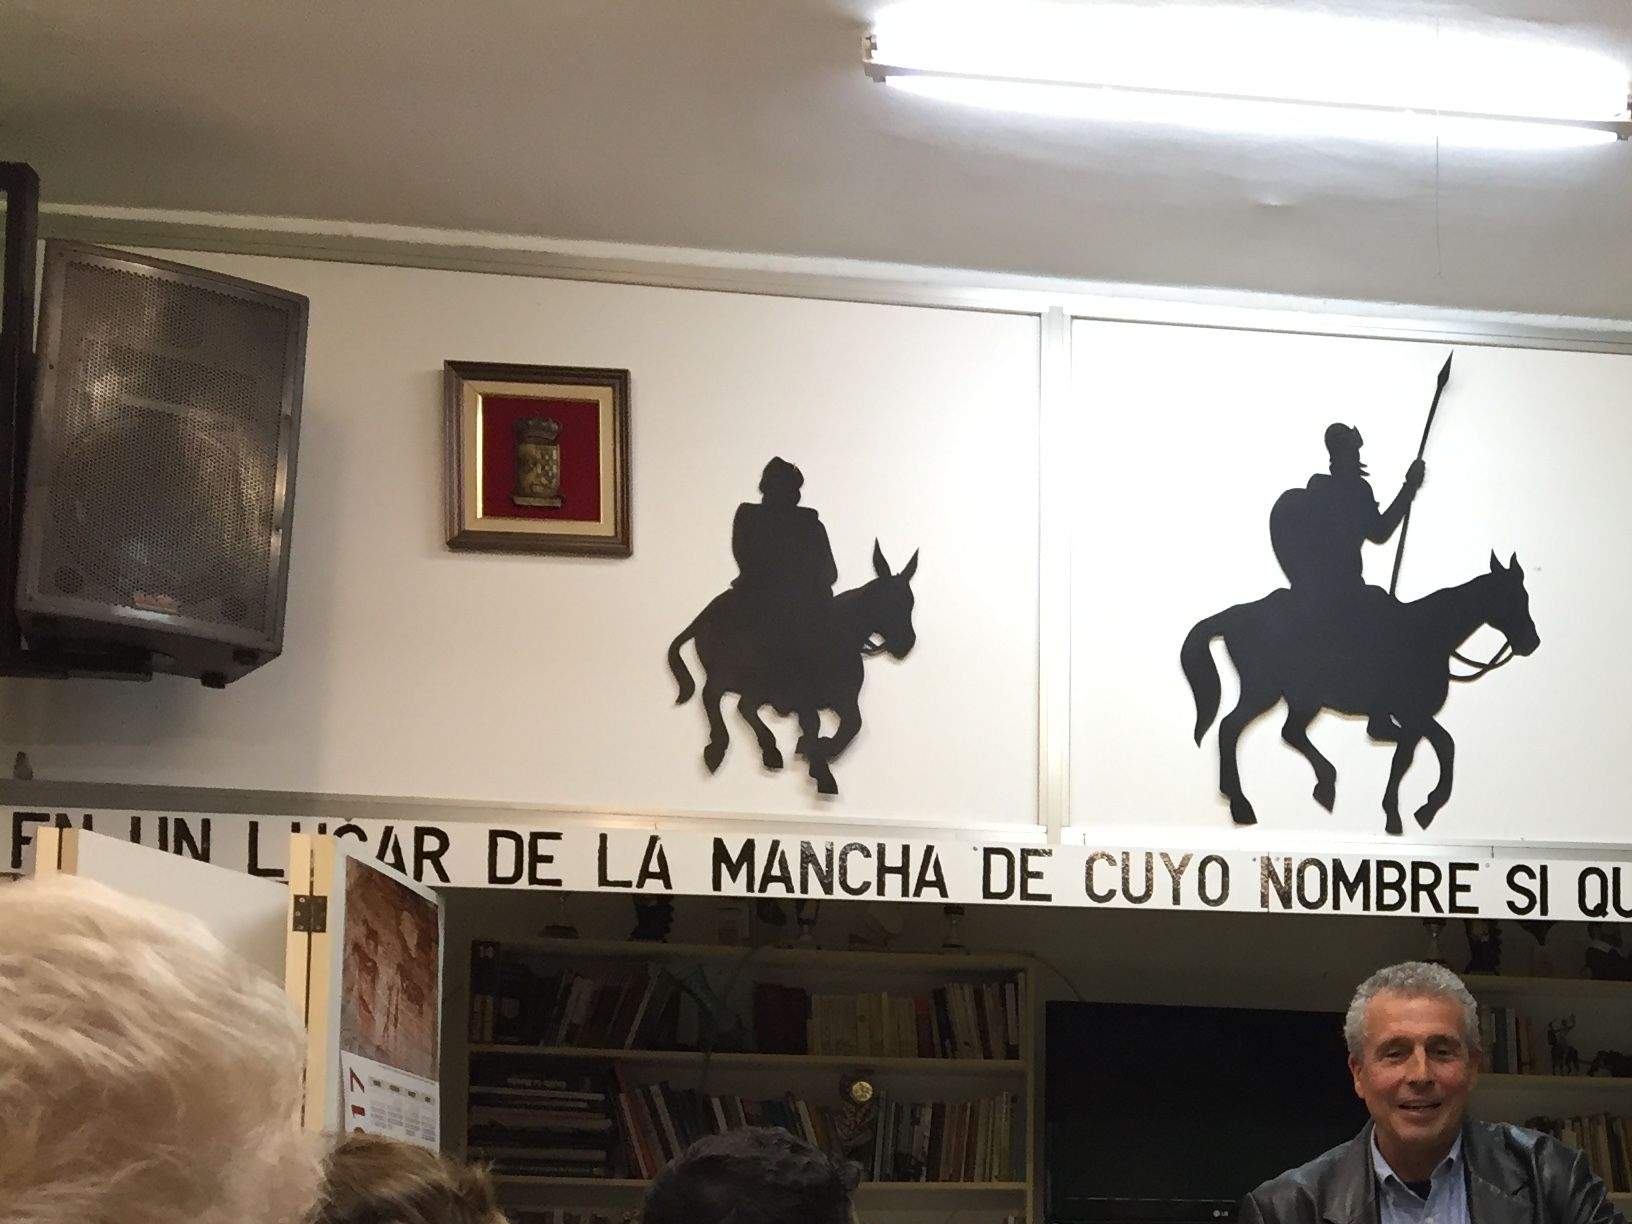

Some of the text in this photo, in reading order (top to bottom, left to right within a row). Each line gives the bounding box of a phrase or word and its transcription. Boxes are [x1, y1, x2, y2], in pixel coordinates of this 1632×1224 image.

[487, 829, 563, 887] DE
[598, 833, 673, 890] LA
[712, 837, 949, 899] MANCHA
[982, 846, 1053, 902] DE
[1085, 850, 1231, 907] CUYO
[1260, 854, 1480, 915] NOMBRE
[1506, 863, 1549, 917] SI
